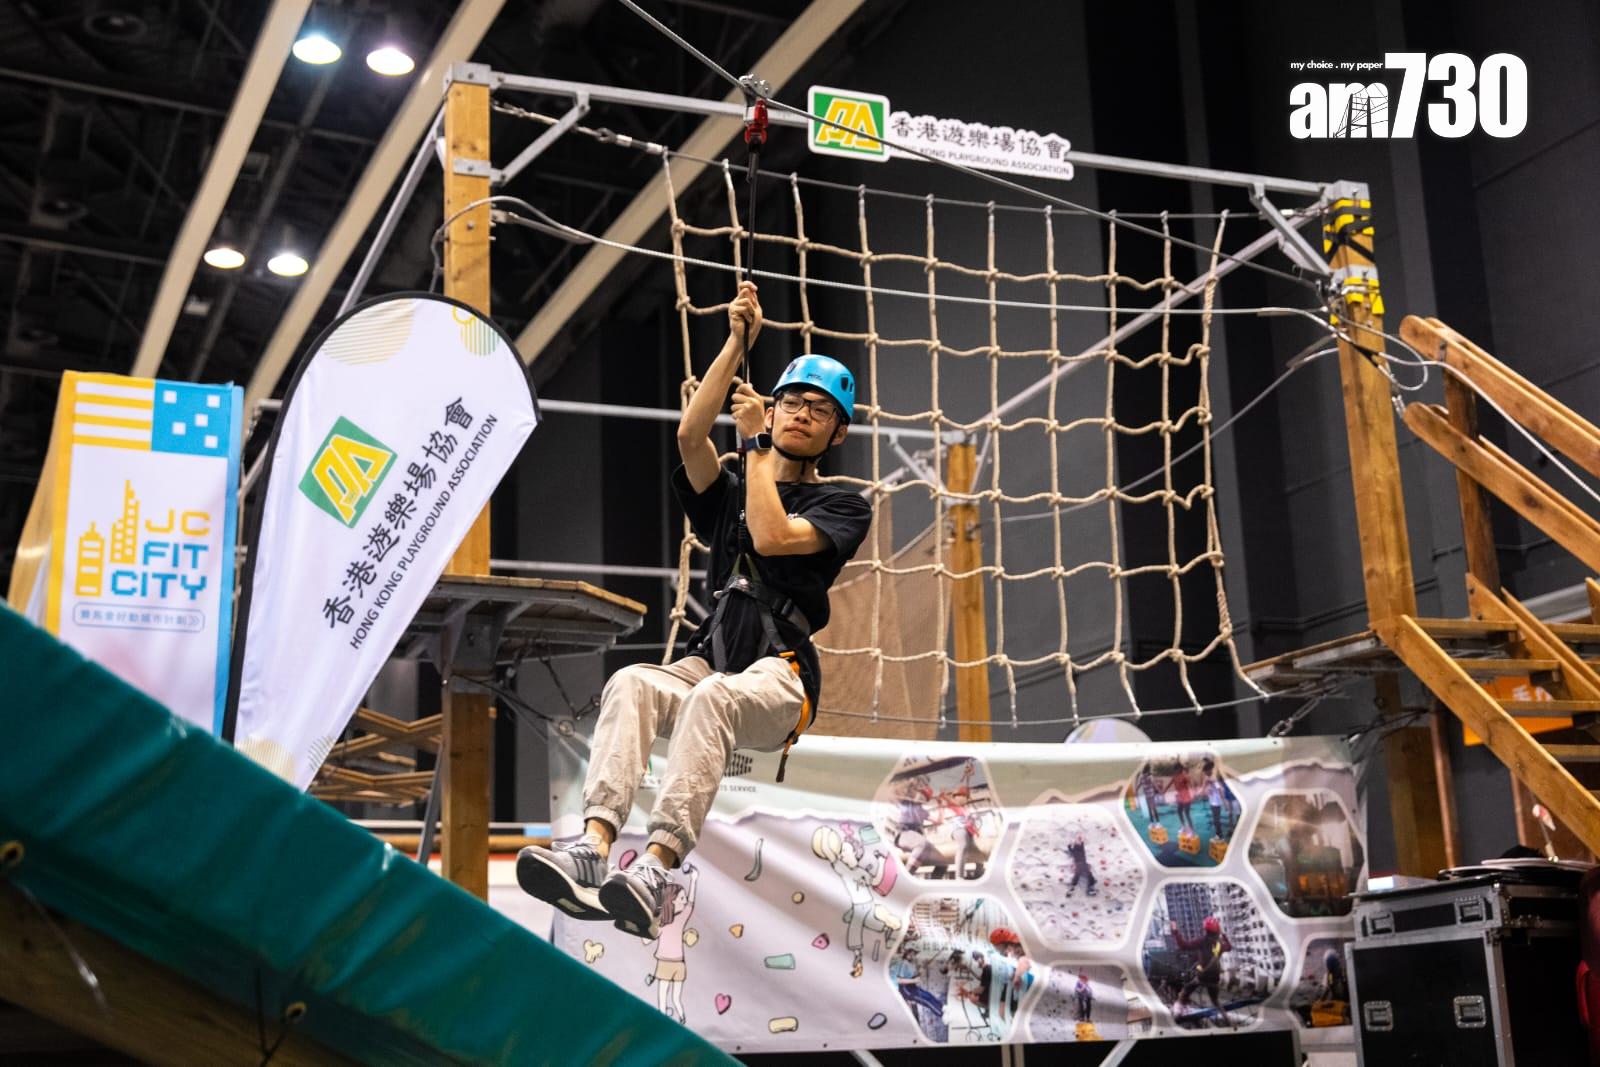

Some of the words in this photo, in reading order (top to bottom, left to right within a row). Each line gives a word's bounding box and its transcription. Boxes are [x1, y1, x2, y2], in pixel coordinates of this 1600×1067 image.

[891, 116, 1069, 159] 香港遊樂場協會
[948, 151, 1010, 167] PLAYGROUND
[1011, 160, 1070, 175] ASSOCIATION
[144, 508, 211, 535] JC
[322, 396, 473, 629] 香港遊樂場協會
[349, 611, 380, 650] HONG
[378, 575, 404, 612] KONG
[397, 489, 452, 575] PLAYGROUND
[447, 413, 498, 492] ASSOCIATION
[142, 540, 209, 569] FIT
[111, 569, 208, 601] CITY
